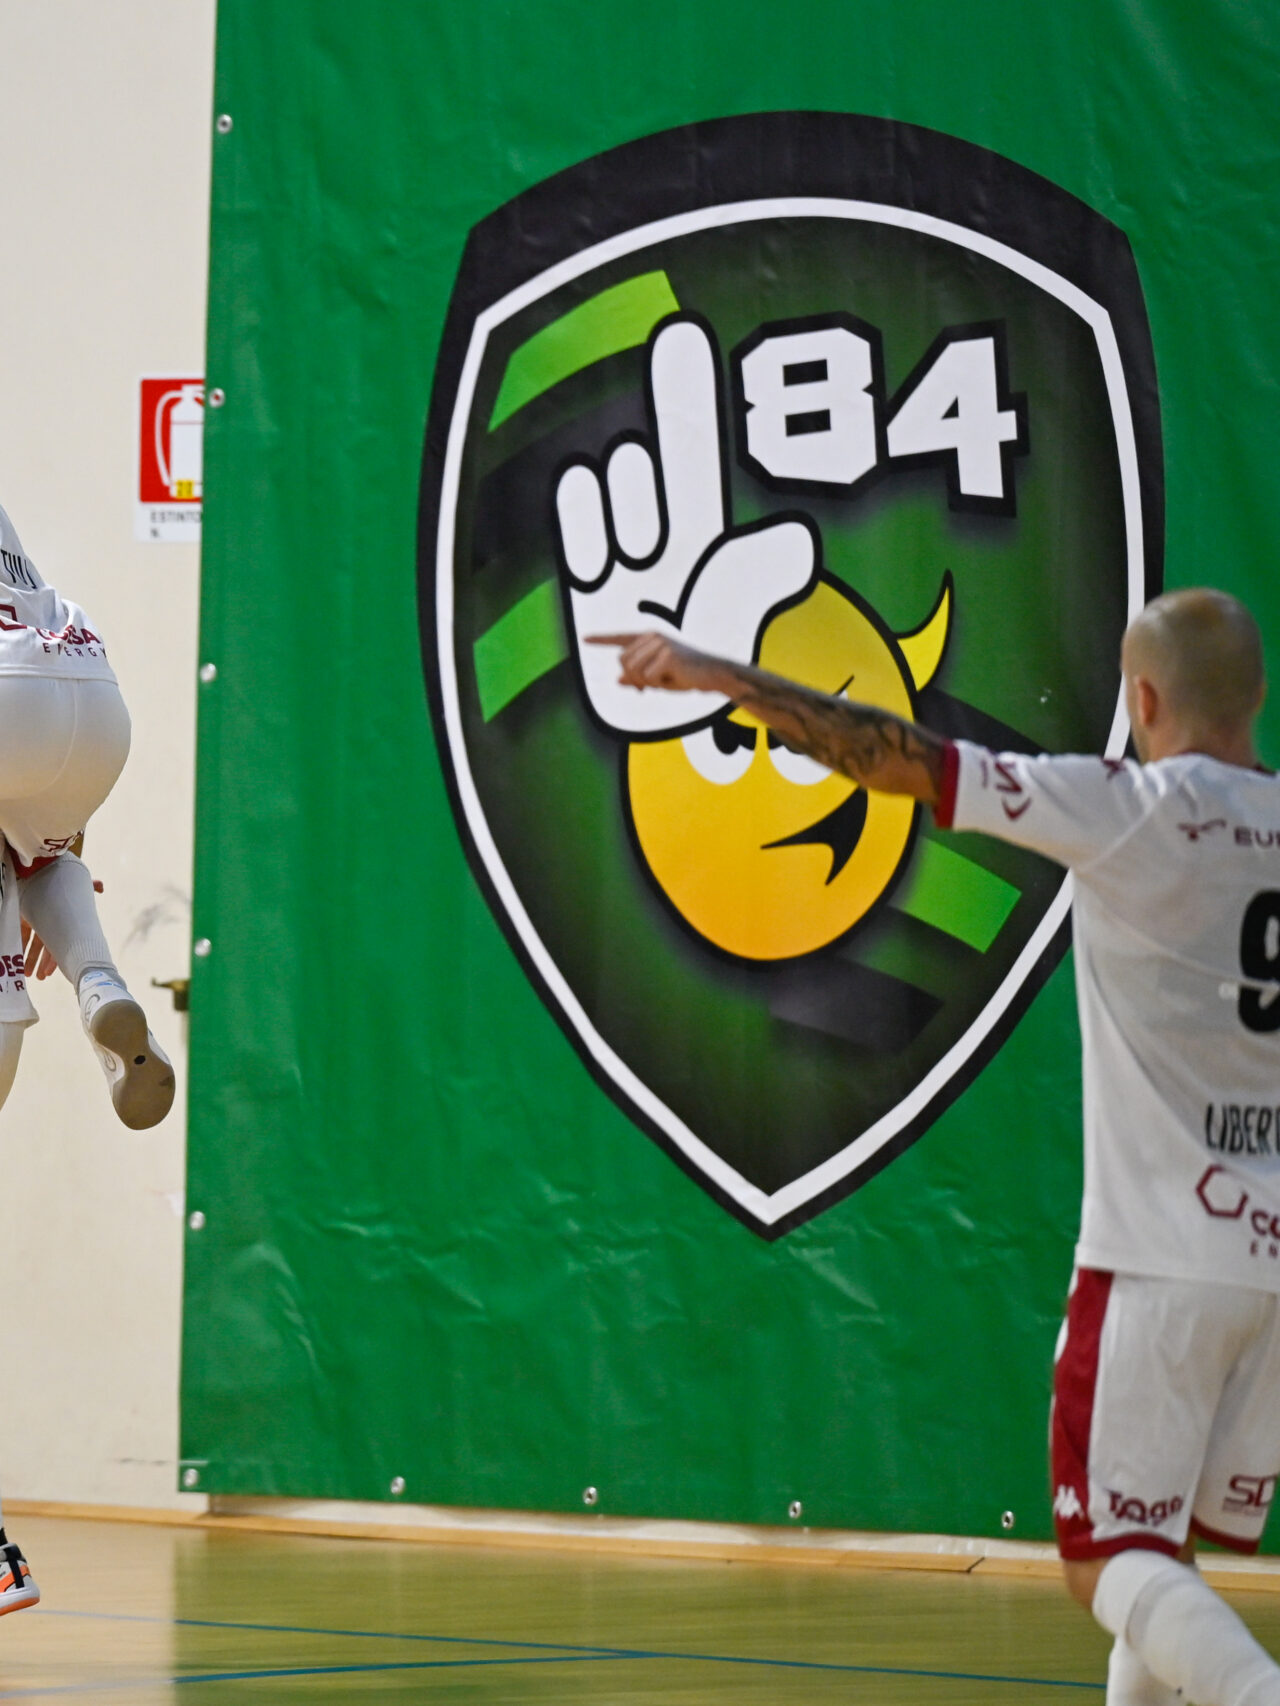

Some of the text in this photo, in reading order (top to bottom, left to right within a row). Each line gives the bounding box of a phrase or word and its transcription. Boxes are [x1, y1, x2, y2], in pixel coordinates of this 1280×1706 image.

[740, 326, 1018, 499] 84
[1233, 825, 1280, 849] EU
[1205, 1102, 1280, 1155] LIBER
